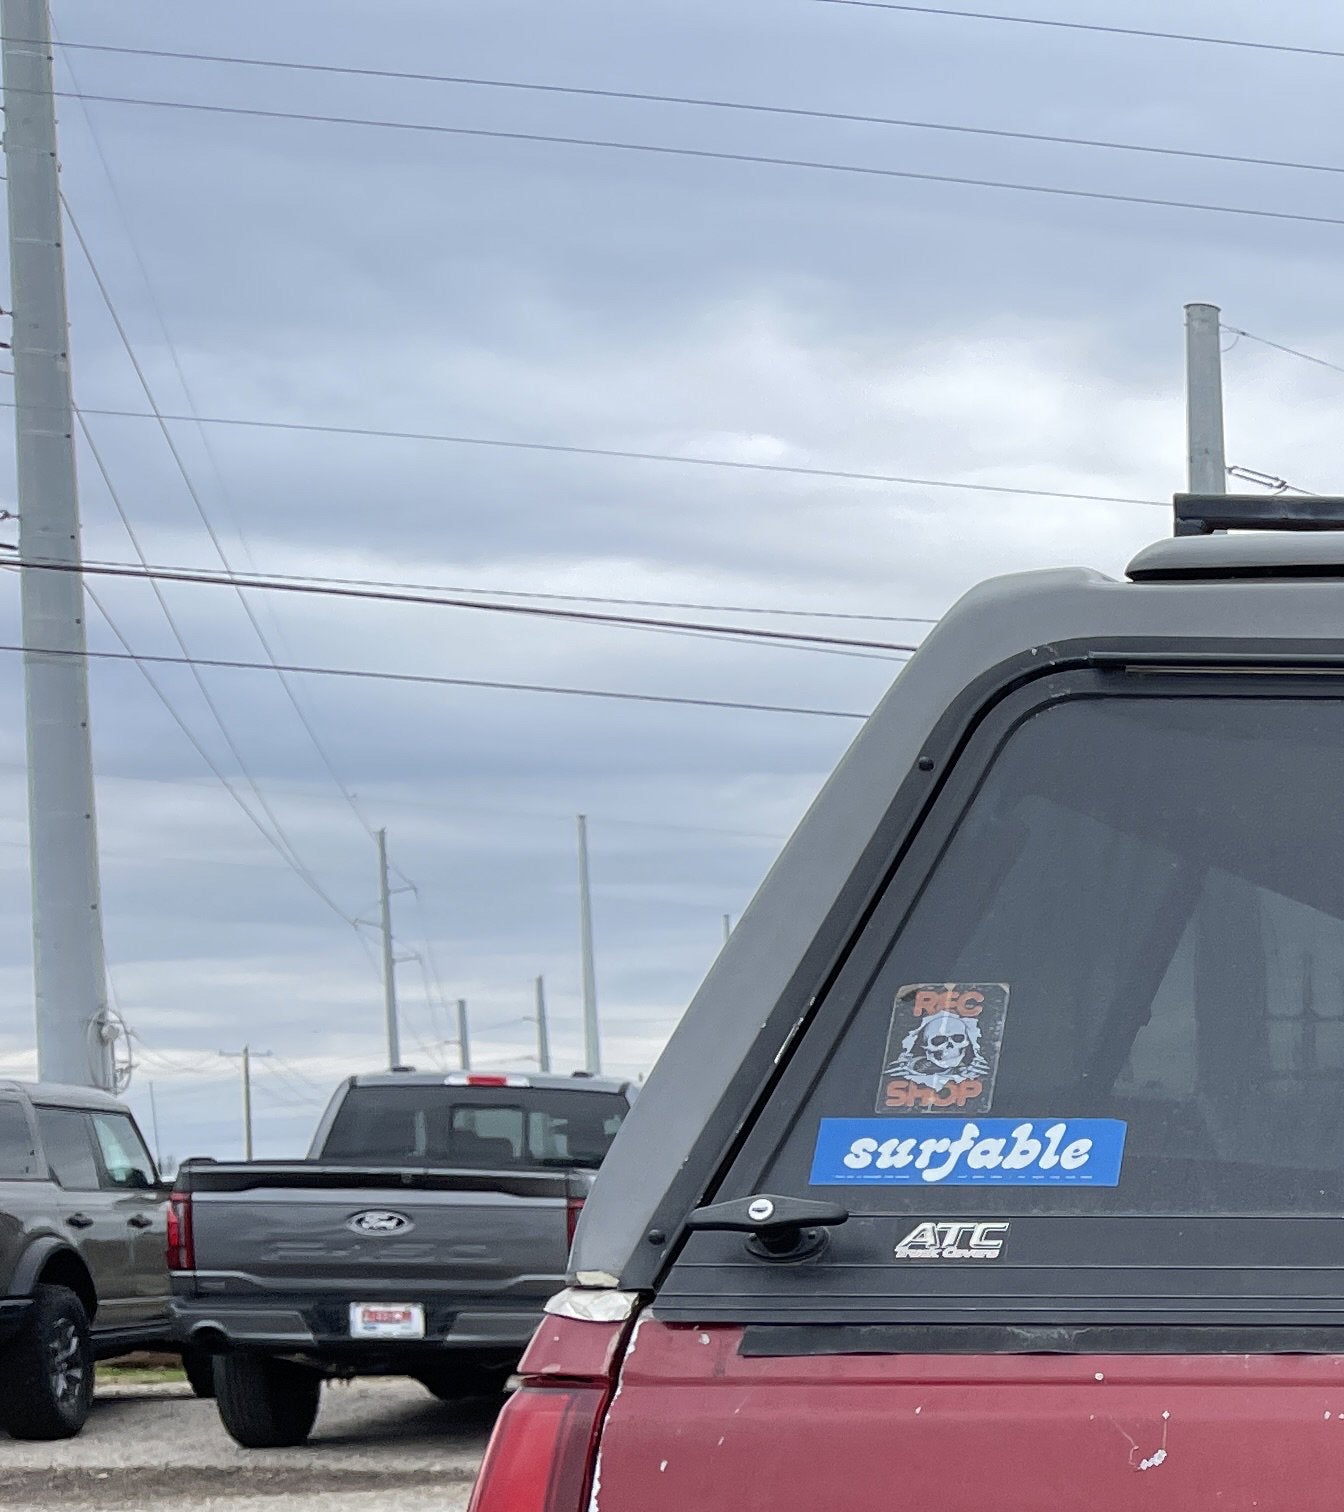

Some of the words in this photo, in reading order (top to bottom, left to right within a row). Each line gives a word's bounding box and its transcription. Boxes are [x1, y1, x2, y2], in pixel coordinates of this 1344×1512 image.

[885, 1077, 983, 1107] SHOP
[843, 1122, 1093, 1182] surfable
[896, 1222, 1010, 1249] ATC
